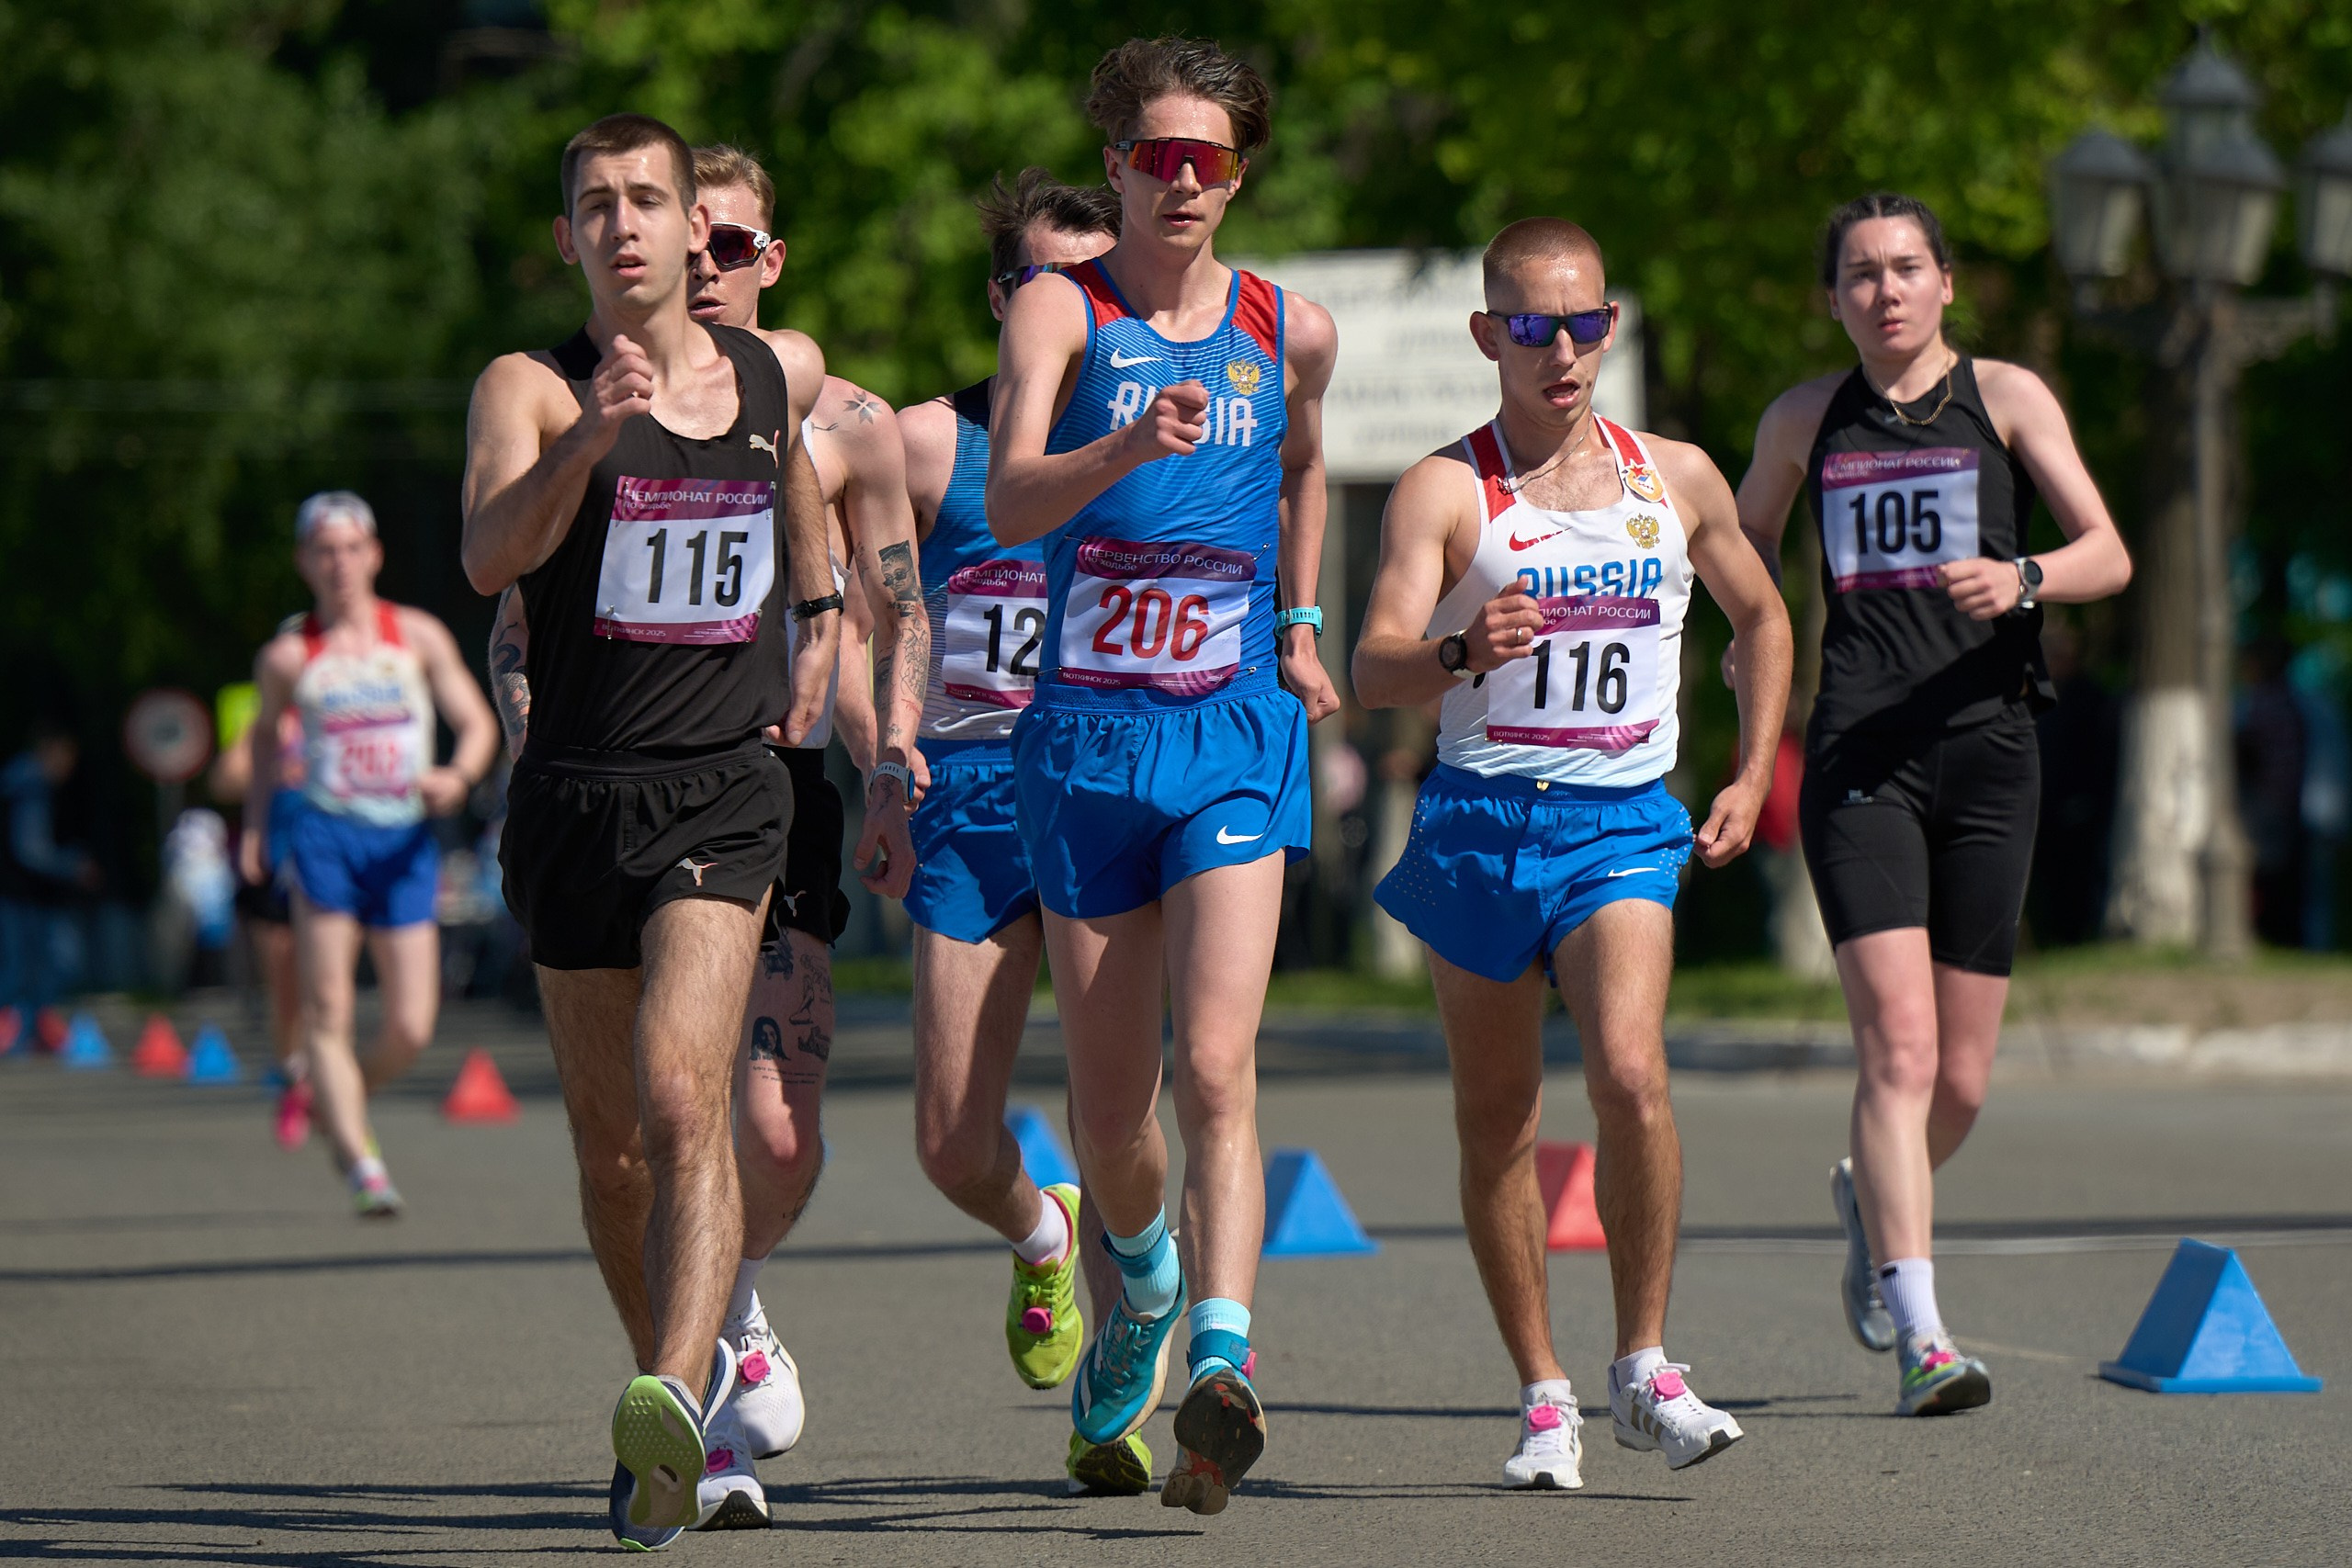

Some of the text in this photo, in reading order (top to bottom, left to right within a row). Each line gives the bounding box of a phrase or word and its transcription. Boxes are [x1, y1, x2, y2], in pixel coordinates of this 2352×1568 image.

[1107, 381, 1258, 447] RIA
[626, 490, 767, 504] ЧЕМПИОНАТ РОССИИ
[1849, 489, 1941, 555] 105
[647, 528, 749, 607] 115
[1084, 555, 1137, 571] по ходьбе
[1085, 547, 1243, 575] ПЕРВЕНСТВО РОССИИ
[1517, 558, 1663, 599] RUSSIA
[1091, 585, 1210, 661] 206
[1598, 606, 1651, 620] РОССИИ
[1102, 677, 1121, 686] 2025
[1532, 639, 1631, 715] 116
